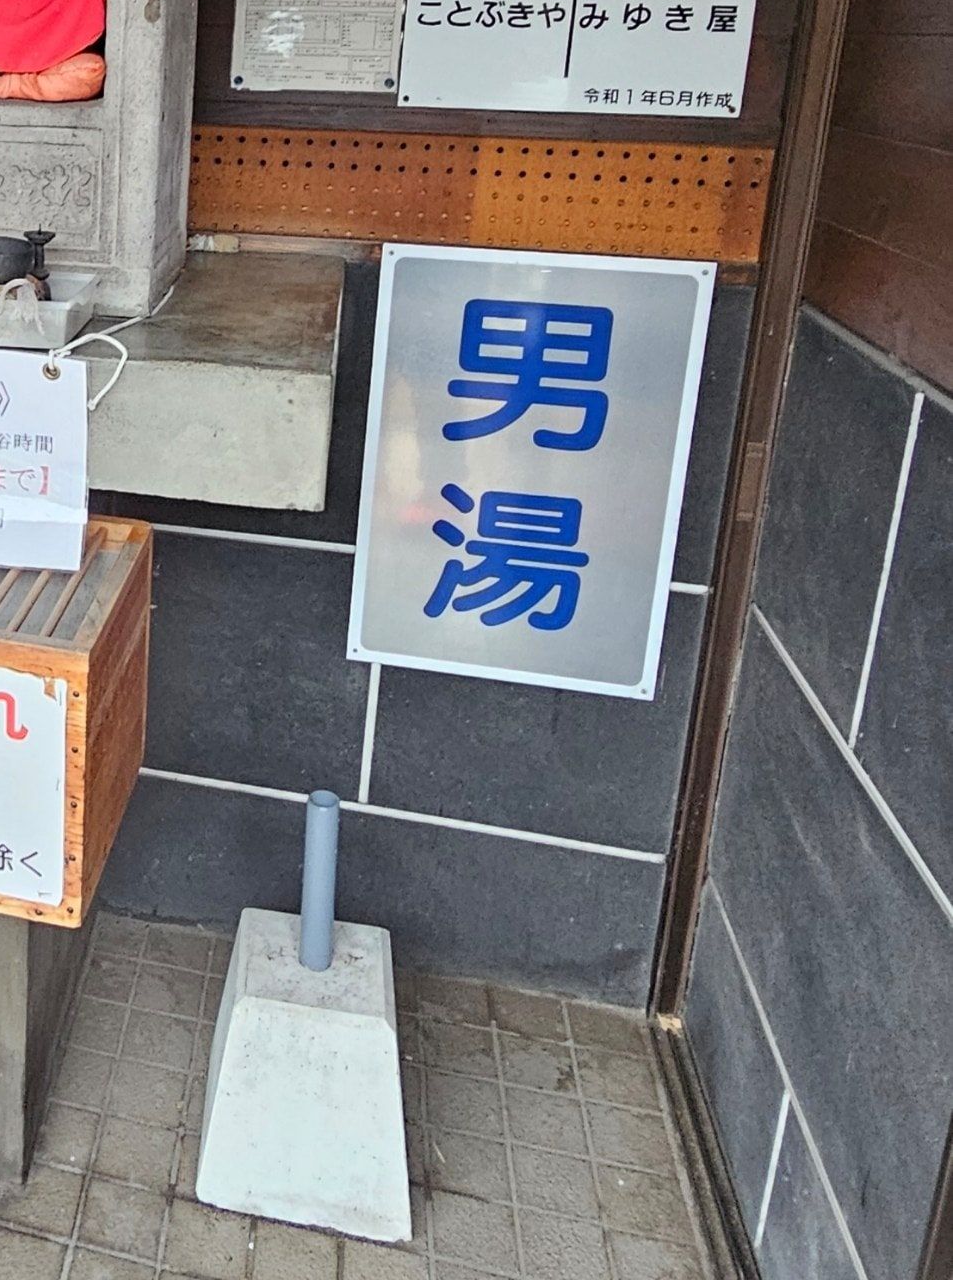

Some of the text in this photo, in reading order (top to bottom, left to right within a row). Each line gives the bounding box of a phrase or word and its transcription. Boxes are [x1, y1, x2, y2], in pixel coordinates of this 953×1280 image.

[417, 1, 566, 28] ことぶきや
[579, 3, 738, 32] みゆき屋
[423, 298, 614, 631] 男湯
